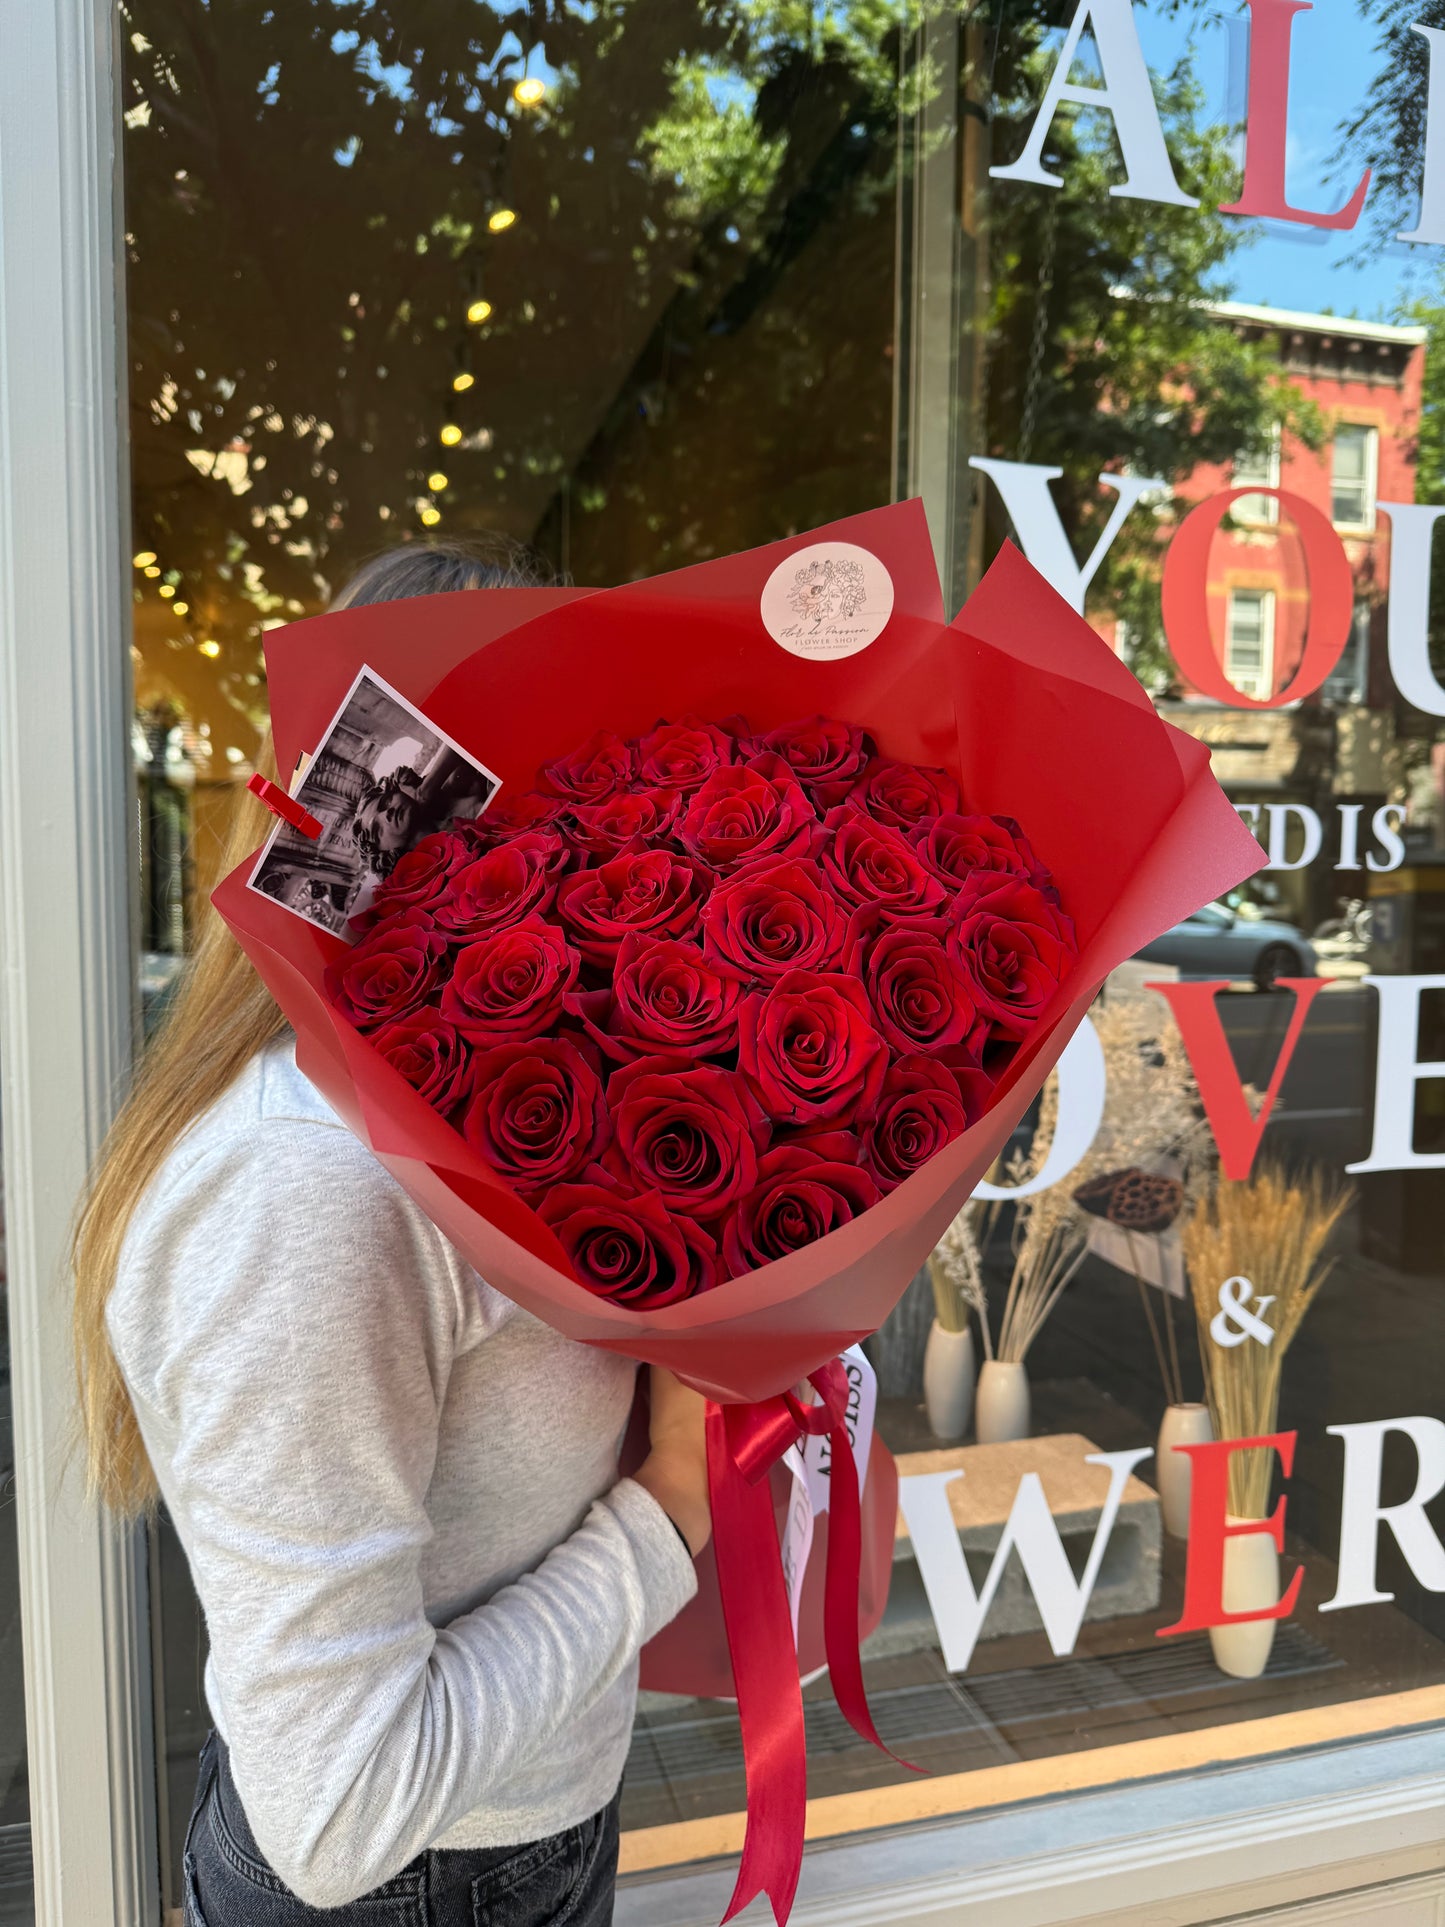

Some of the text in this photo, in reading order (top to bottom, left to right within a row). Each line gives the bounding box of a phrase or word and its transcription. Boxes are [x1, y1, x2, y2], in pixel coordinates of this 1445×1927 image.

[795, 637, 858, 646] FLOWER SHOP
[1333, 803, 1407, 872] IS
[1210, 1275, 1277, 1348] &
